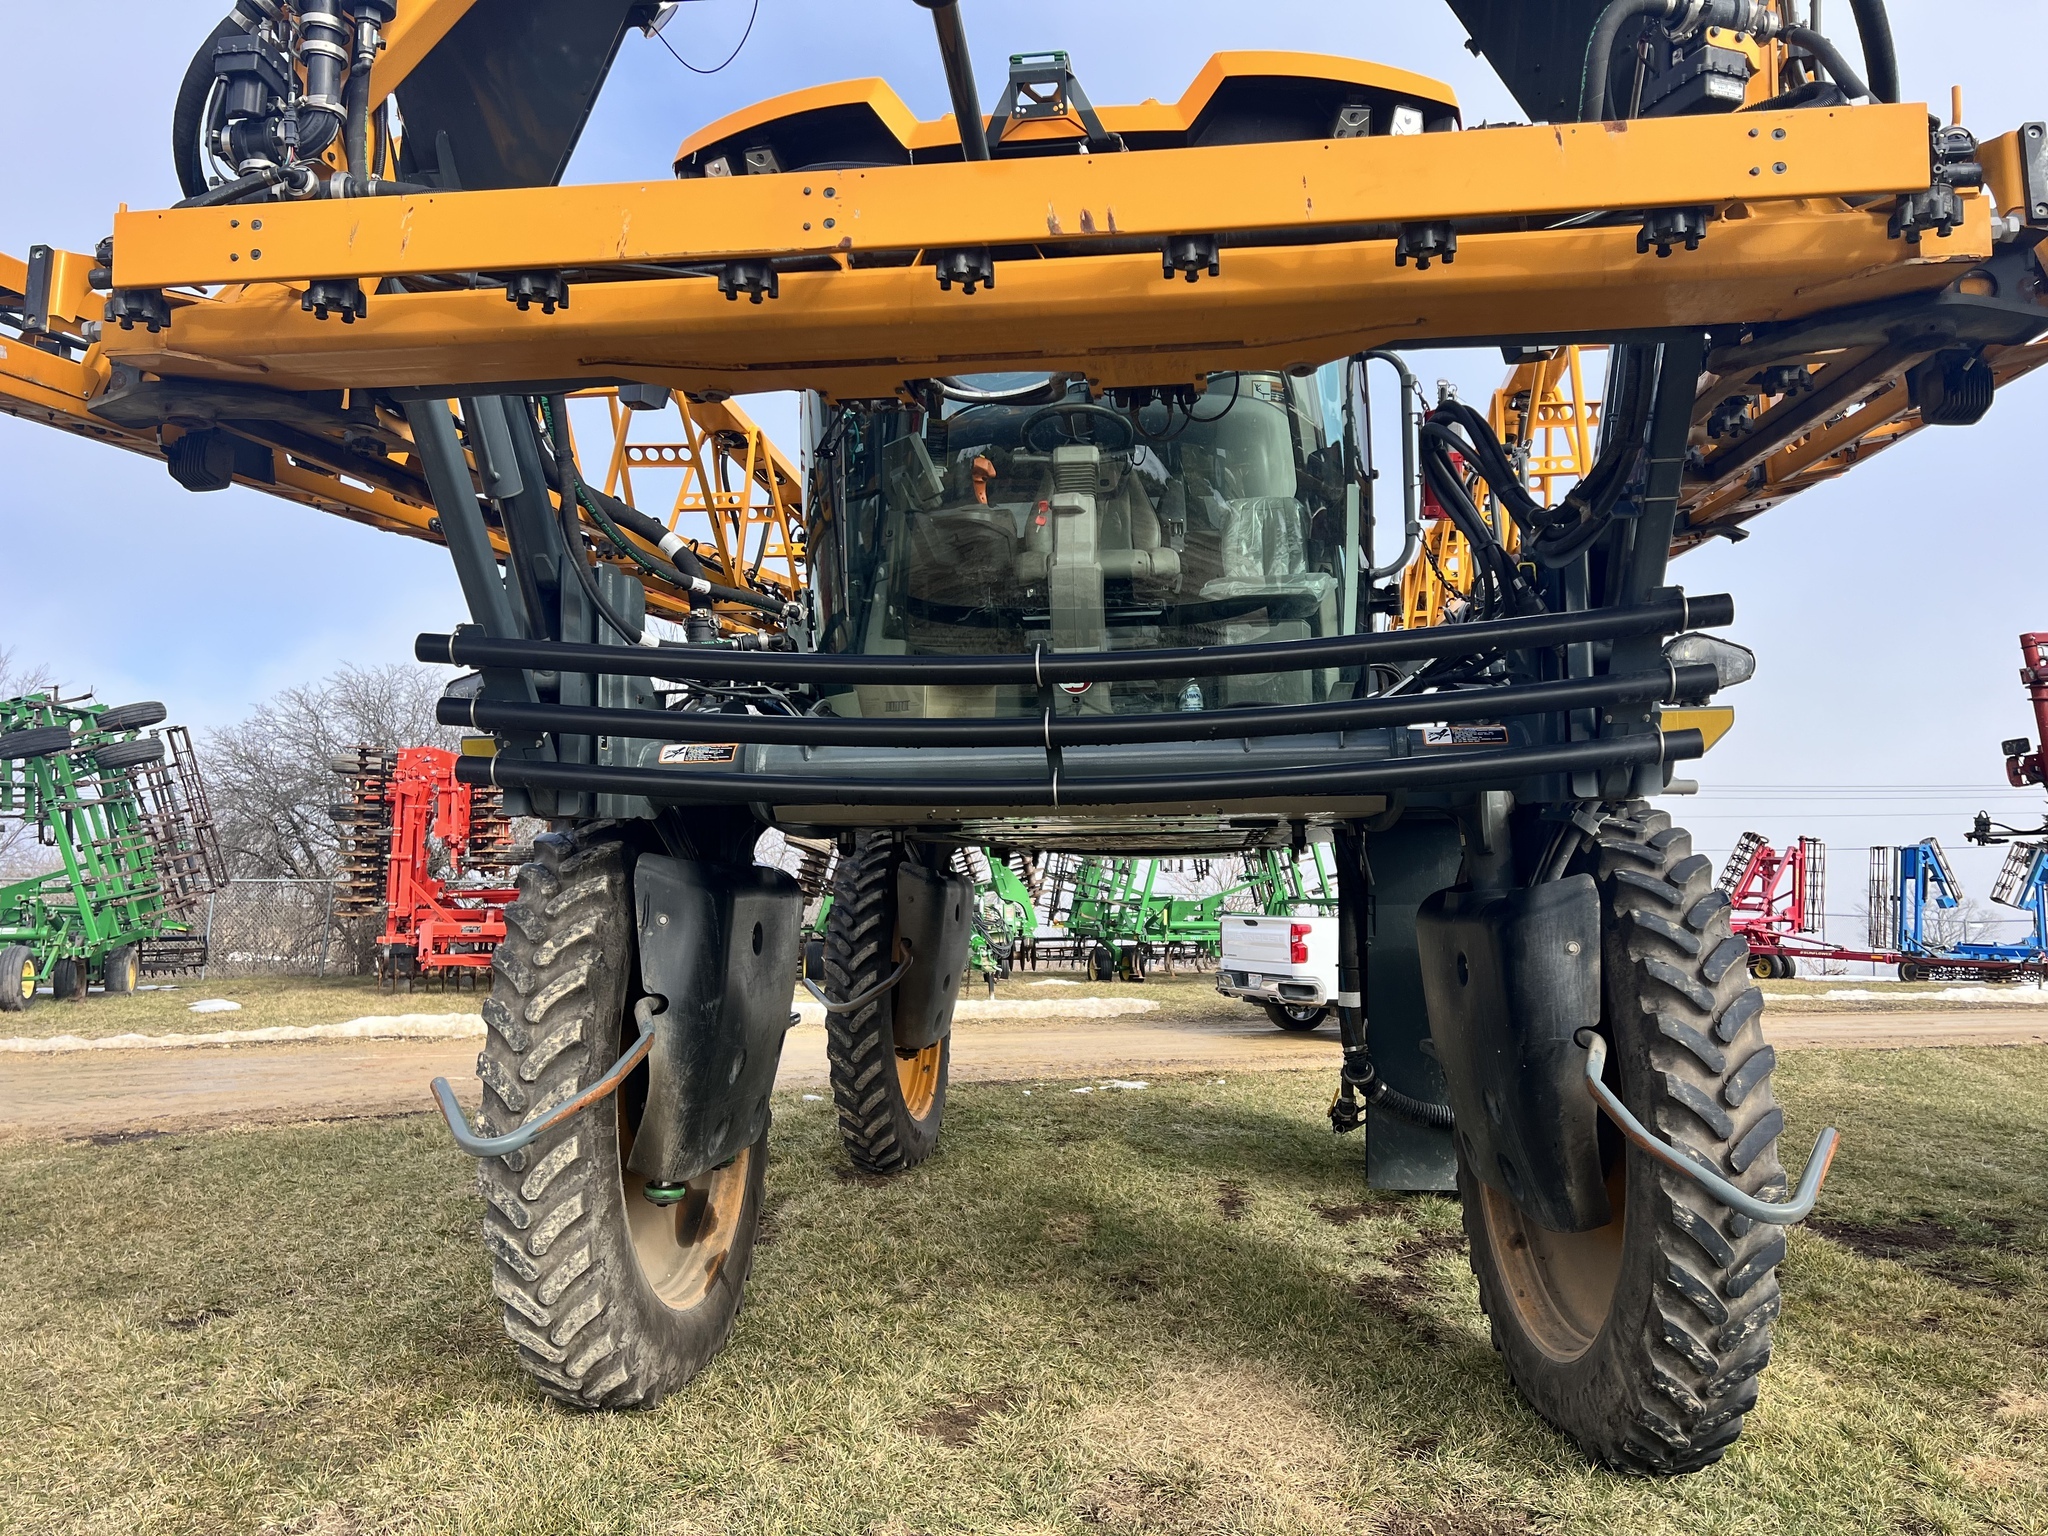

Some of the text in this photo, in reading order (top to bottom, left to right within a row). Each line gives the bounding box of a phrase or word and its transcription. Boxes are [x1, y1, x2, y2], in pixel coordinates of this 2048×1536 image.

[601, 523, 625, 547] GENERAL
[626, 548, 652, 568] PURPOSE
[1225, 932, 1283, 943] CHEVROLET
